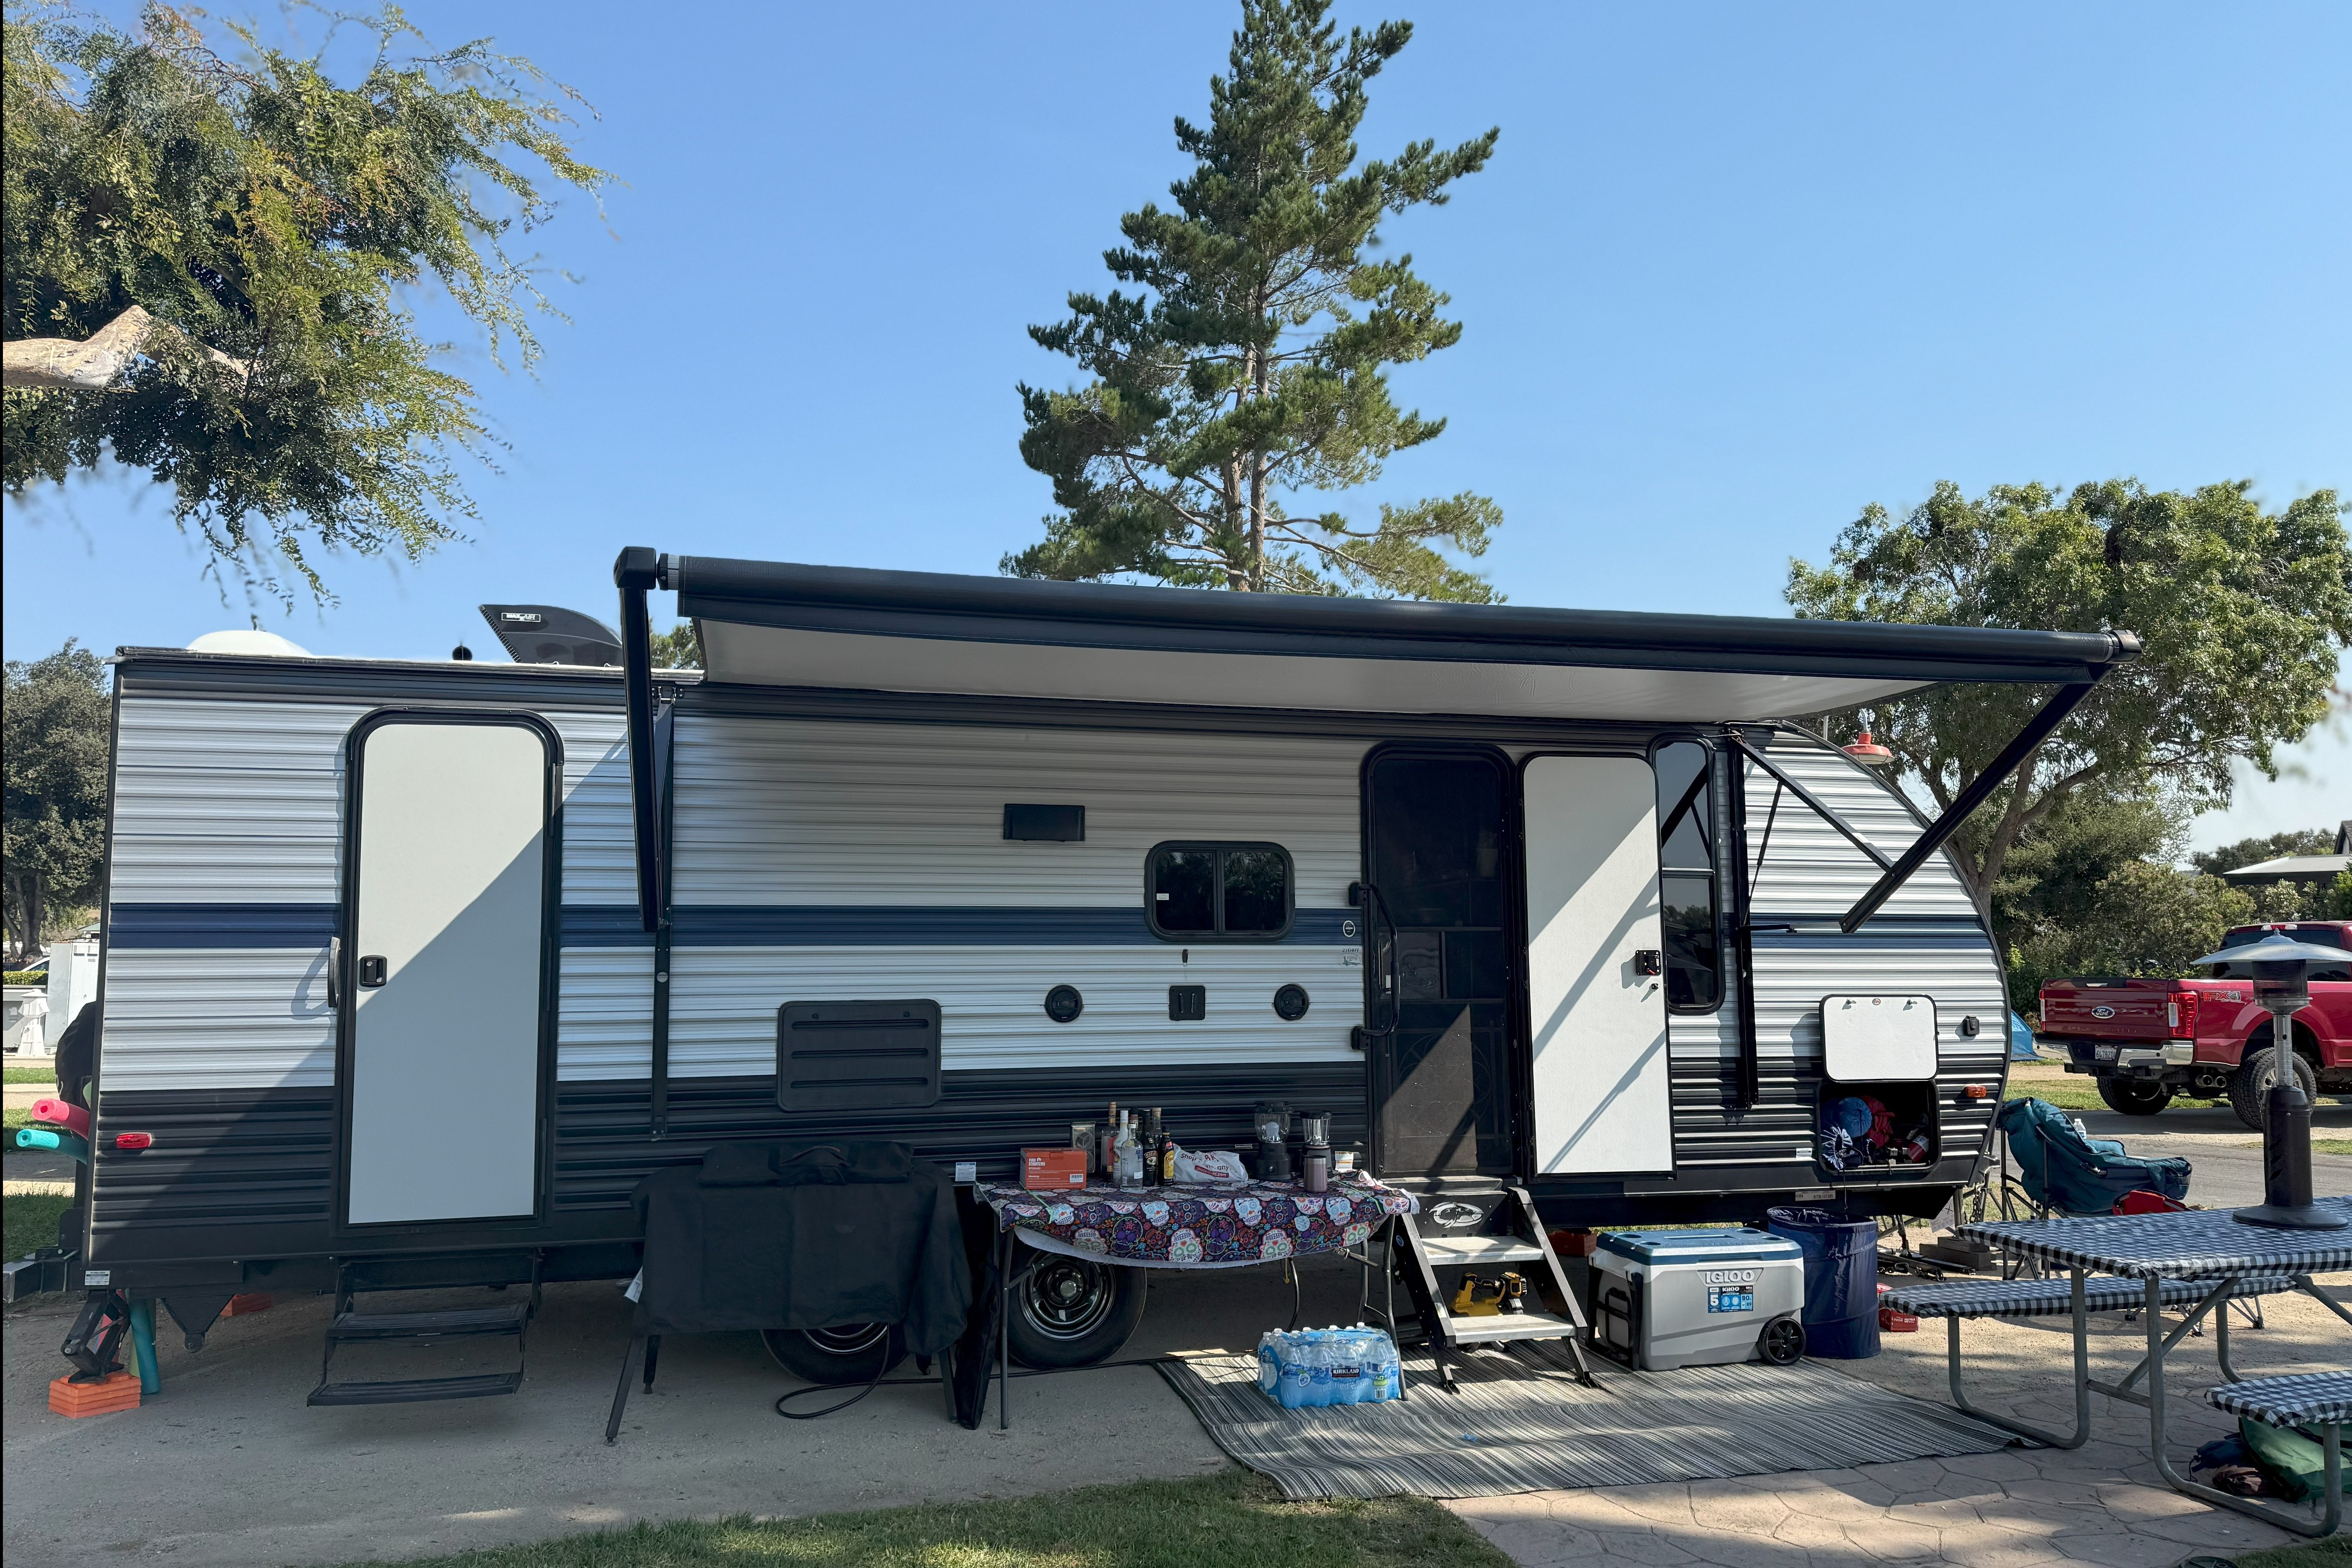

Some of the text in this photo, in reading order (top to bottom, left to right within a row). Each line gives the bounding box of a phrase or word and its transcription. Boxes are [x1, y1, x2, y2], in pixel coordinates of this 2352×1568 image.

[2204, 991, 2241, 1001] FX4
[1180, 1153, 1198, 1162] shop
[1706, 1270, 1755, 1284] IGLOO
[1710, 1294, 1719, 1306] 5
[1323, 1382, 1349, 1392] purified
